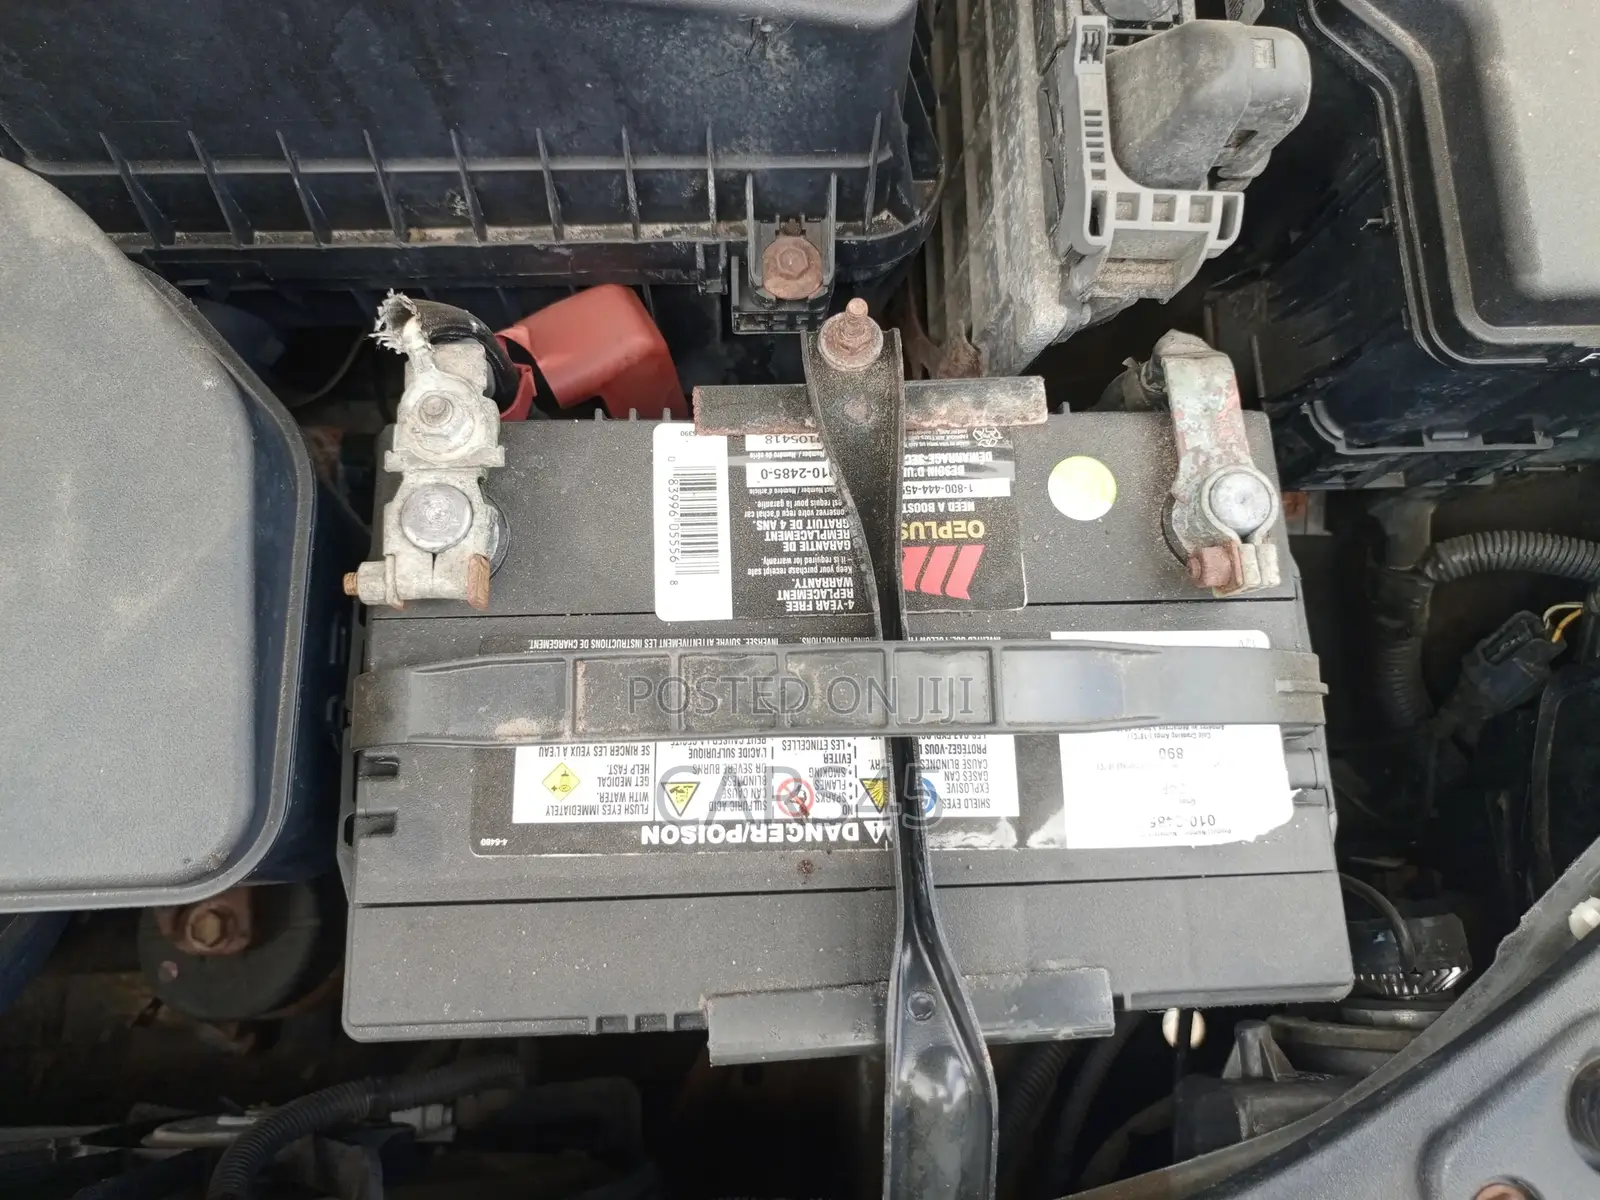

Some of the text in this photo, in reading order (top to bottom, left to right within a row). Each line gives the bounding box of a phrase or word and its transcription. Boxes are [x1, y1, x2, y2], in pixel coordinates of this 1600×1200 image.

[765, 435, 820, 444] 105418
[761, 468, 831, 479] 10-2485-0
[928, 465, 964, 477] BESOIN
[668, 479, 679, 517] 83996
[755, 499, 784, 508] garantie.
[794, 499, 808, 507] pour
[810, 498, 830, 507] requis
[938, 502, 945, 512] A
[948, 502, 975, 511] NEED
[782, 508, 796, 517] reçu
[816, 509, 846, 517] onservez
[753, 519, 849, 530] GRATUIT DE 4 ANS.
[765, 530, 850, 541] REMPLACEMENT
[669, 524, 679, 562] 05556
[783, 540, 851, 552] GARANTIE DE
[761, 556, 792, 565] warranty.
[794, 557, 802, 565] for
[804, 555, 831, 564] required
[748, 568, 762, 576] safe
[764, 566, 786, 576] receipt
[788, 566, 818, 575] purchase
[836, 565, 852, 574] Keep
[792, 577, 853, 588] WARRANTY.
[777, 588, 853, 600] REPLACEMENT
[786, 600, 854, 611] 4-YEAR FREE
[528, 639, 578, 649] CHARGEMENT.
[580, 639, 588, 649] DE
[591, 638, 642, 649] INSTRUCTIONS
[644, 639, 656, 648] LES
[659, 638, 714, 648] ATTENTIVEMENT
[570, 746, 590, 757] YEUX
[594, 746, 607, 757] LES
[610, 745, 638, 756] RINCER
[640, 746, 650, 756] SE
[782, 739, 845, 753] LES ÉTINCELLES
[925, 744, 986, 757] PROTÉGEZ-VOUS
[538, 747, 560, 757] L'EAU
[688, 747, 766, 759] L'ACIDE SULFURIQUE
[1158, 747, 1184, 760] 890
[823, 753, 851, 767] ÉVITER
[920, 759, 987, 769] CAUSE BLINDNES
[607, 764, 649, 775] HELP FAST.
[692, 763, 766, 774] OR SEVERE BURNS
[808, 767, 845, 777] SMOKING
[597, 776, 649, 788] GET MEDICAL
[722, 775, 766, 786] BLINDNESS
[944, 771, 988, 782] GASES CAN
[815, 780, 846, 790] FLAMES
[946, 782, 989, 794] EXPLOSIVE
[597, 792, 649, 803] WITH WATER.
[722, 788, 766, 799] CAN CAUSE
[815, 792, 846, 803] SPARKS
[709, 800, 767, 812] SULFURIC ACID
[964, 798, 990, 809] SHIELD
[545, 804, 648, 816] FLUSH EYES IMMEDIATELY
[843, 805, 852, 815] NO
[641, 823, 859, 844] DANGER/POISON
